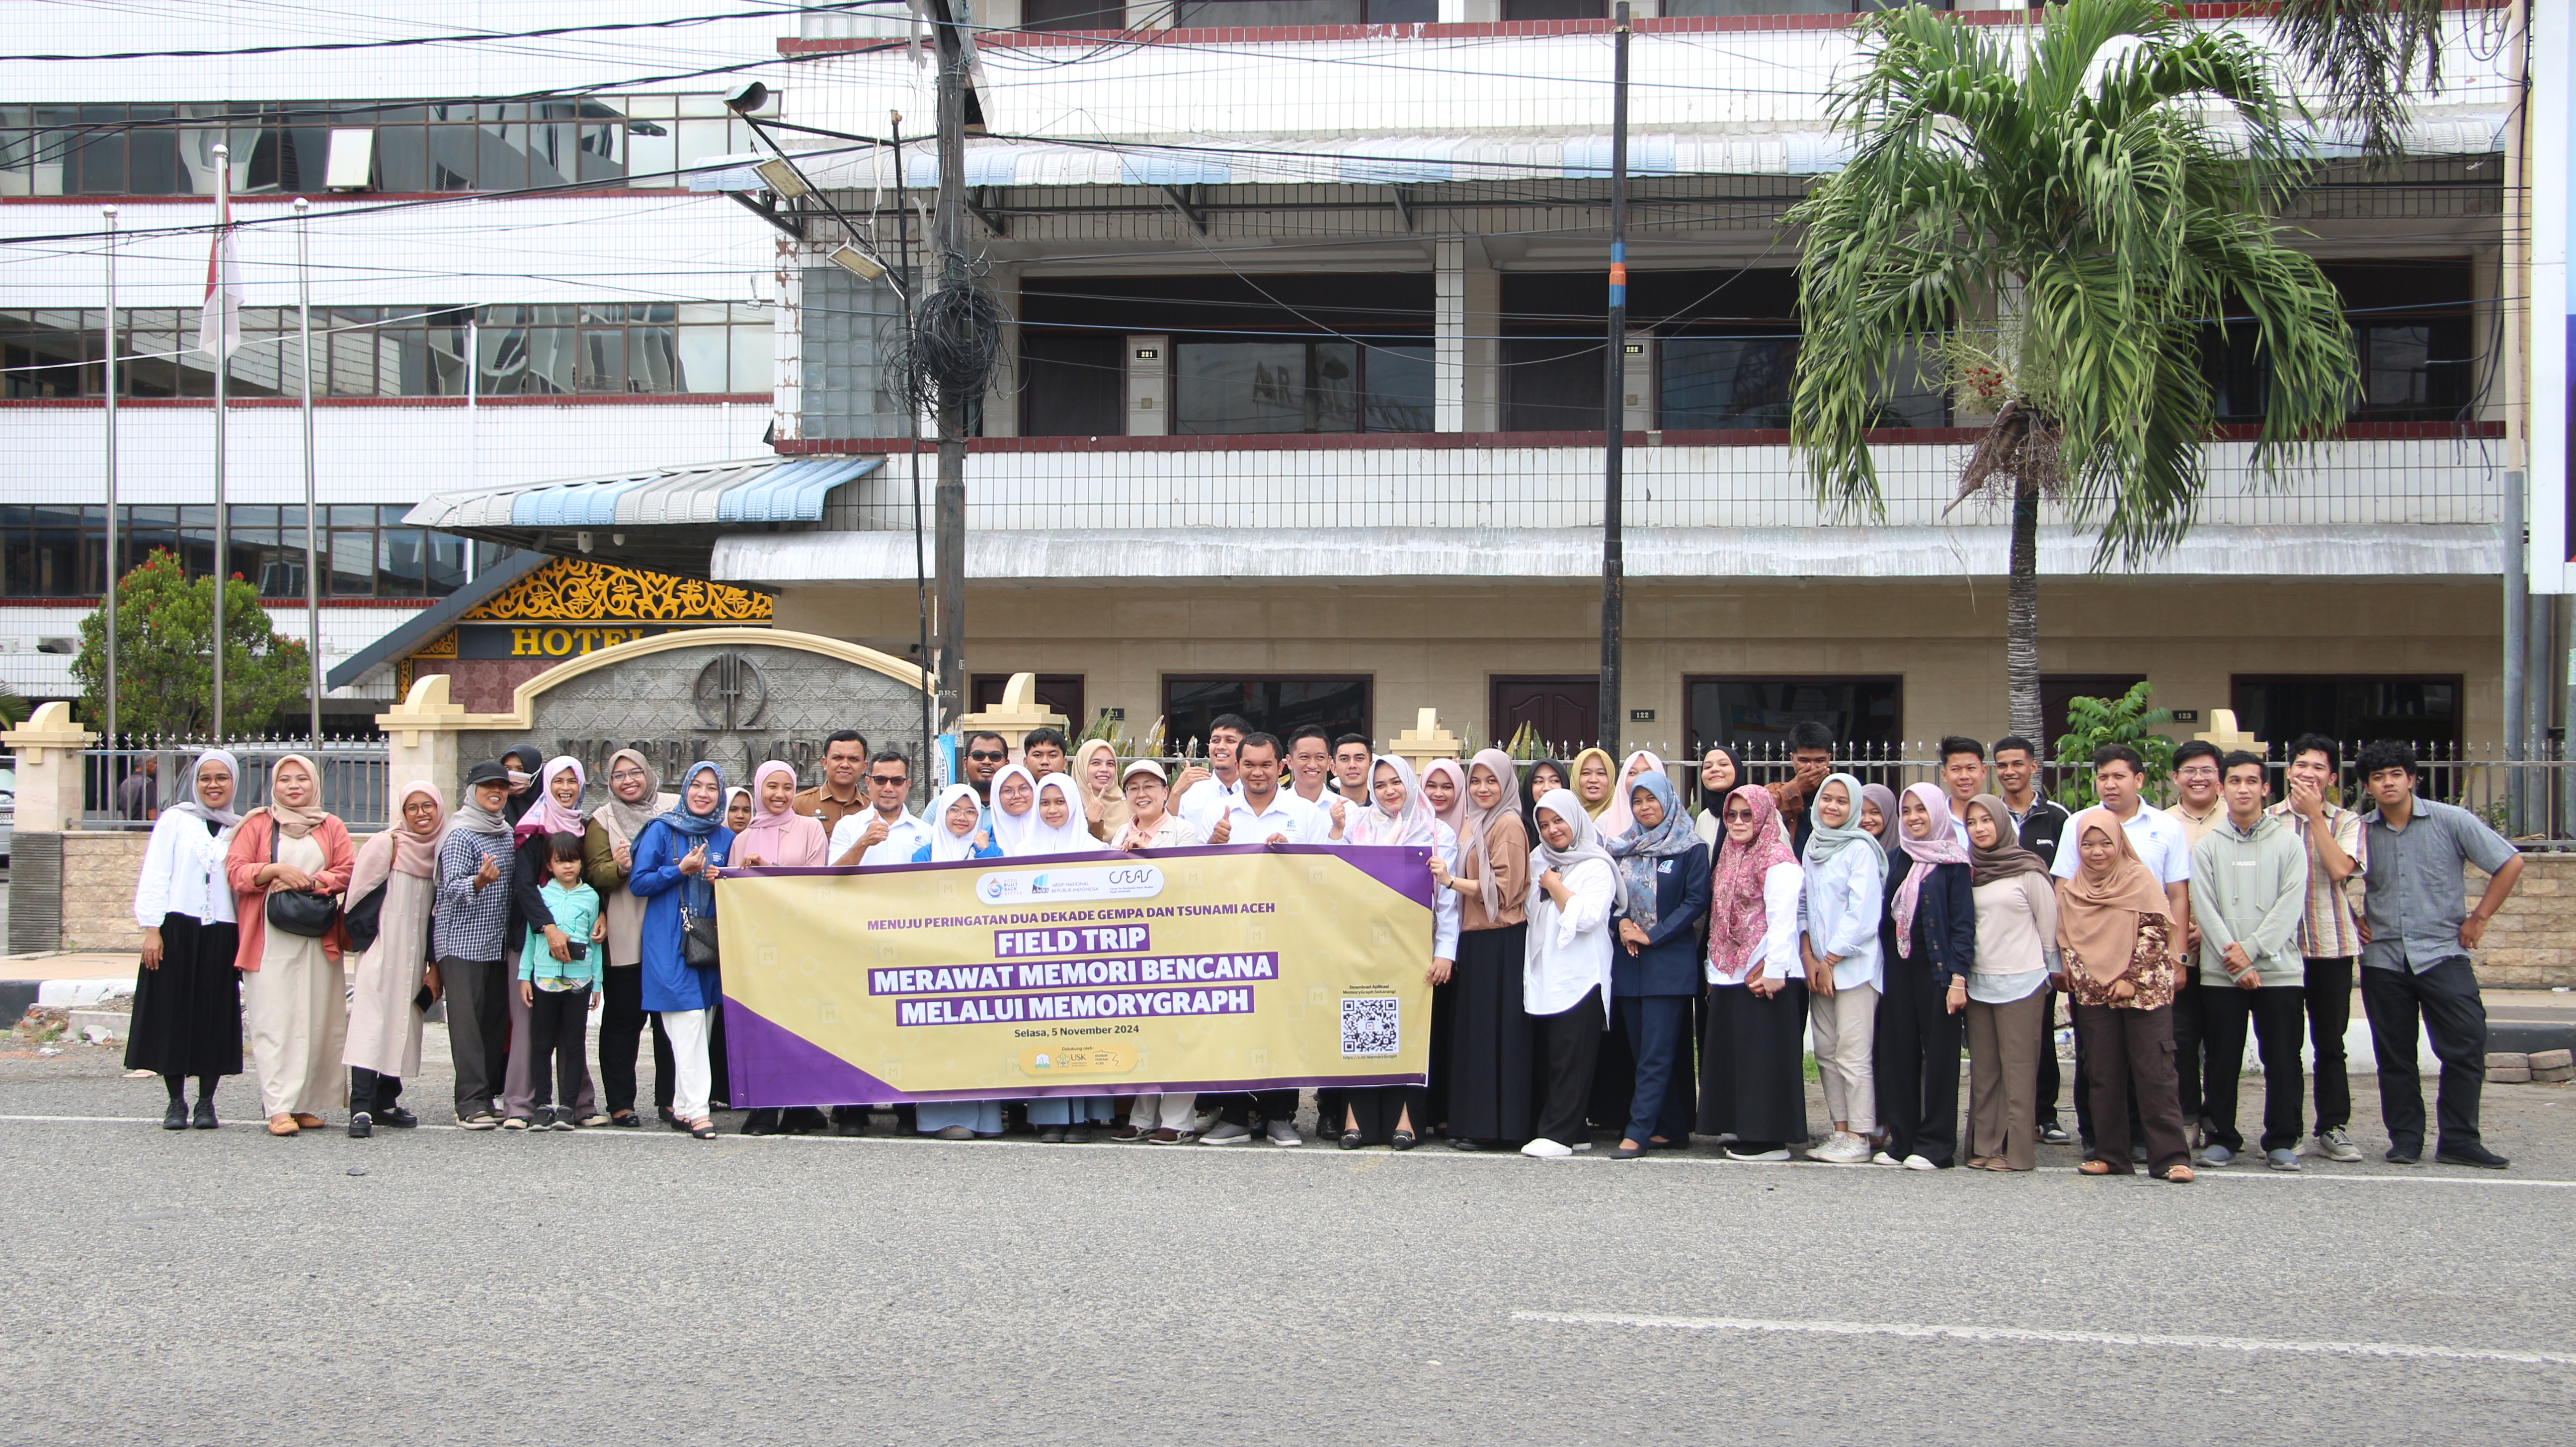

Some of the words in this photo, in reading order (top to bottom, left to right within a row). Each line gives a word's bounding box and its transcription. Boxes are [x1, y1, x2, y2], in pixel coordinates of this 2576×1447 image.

[868, 918, 923, 931] MENUJU
[925, 914, 1008, 928] PERINGATAN
[1011, 912, 1039, 924] DUA
[1041, 910, 1095, 923] DEKADE
[1098, 908, 1144, 920] GEMPA
[1147, 906, 1175, 918] DAN
[1177, 904, 1238, 916] TSUNAMI
[1241, 902, 1275, 913] ACEH
[999, 931, 1077, 955] FIELD
[1082, 927, 1146, 951] TRIP
[875, 965, 1014, 992] MERAWAT
[1019, 960, 1136, 986] MEMORI
[1141, 955, 1273, 981] BENCANA
[902, 999, 1024, 1024] MELALUI
[1029, 989, 1249, 1019] MEMORYGRAPH
[1014, 1029, 1049, 1038] Selasa,
[1060, 1026, 1112, 1036] November
[1115, 1025, 1139, 1034] 2024
